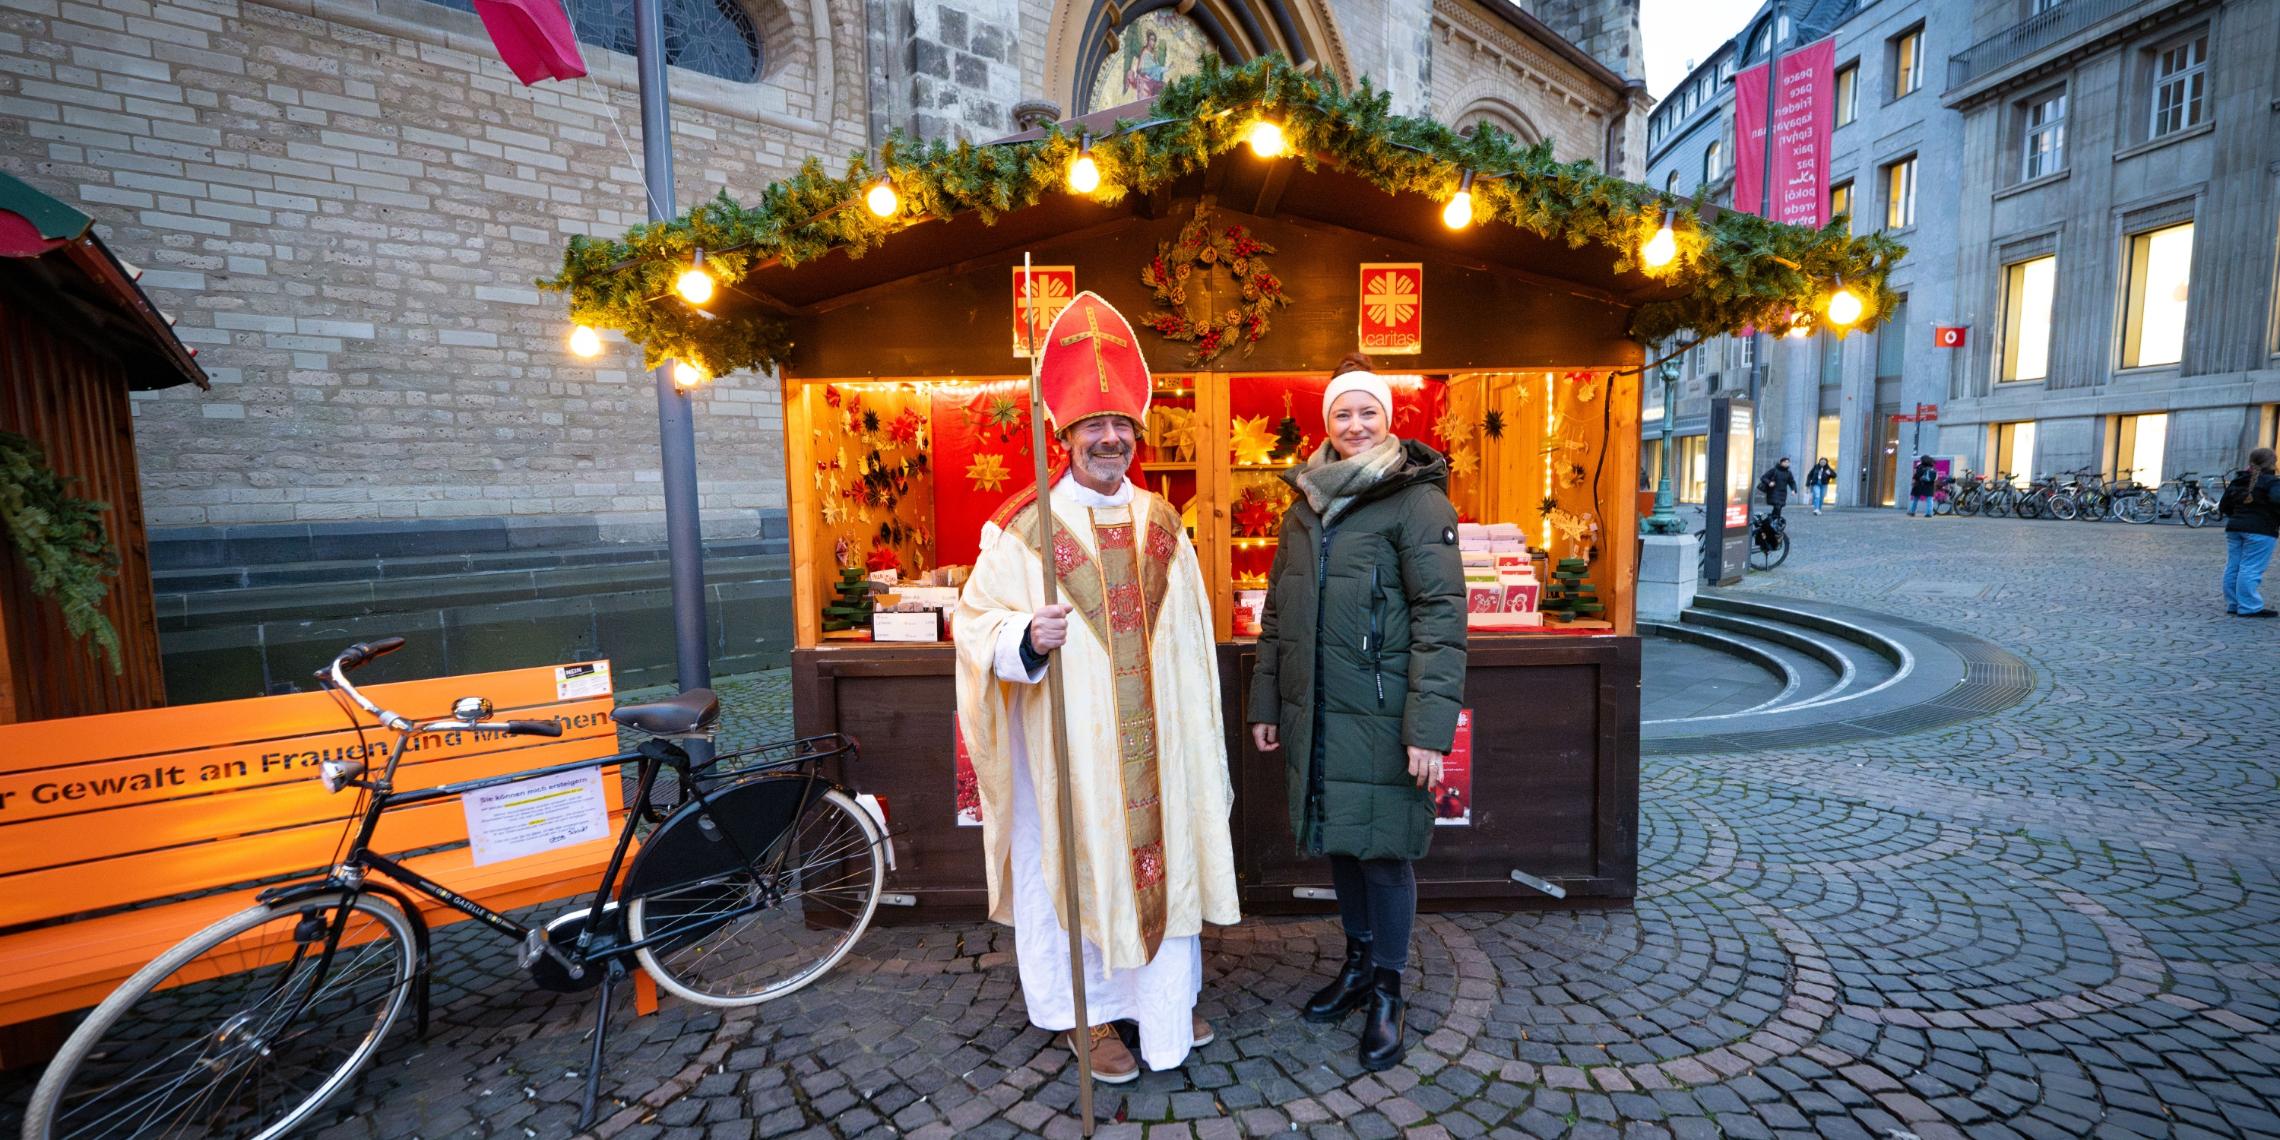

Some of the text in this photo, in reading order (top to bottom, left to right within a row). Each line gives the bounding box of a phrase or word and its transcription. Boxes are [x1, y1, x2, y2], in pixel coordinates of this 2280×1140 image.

[1365, 330, 1416, 346] caritas
[32, 766, 185, 804] Gewalt
[200, 760, 247, 782] an
[262, 741, 388, 773] Frauen
[453, 896, 486, 916] GAZELLE
